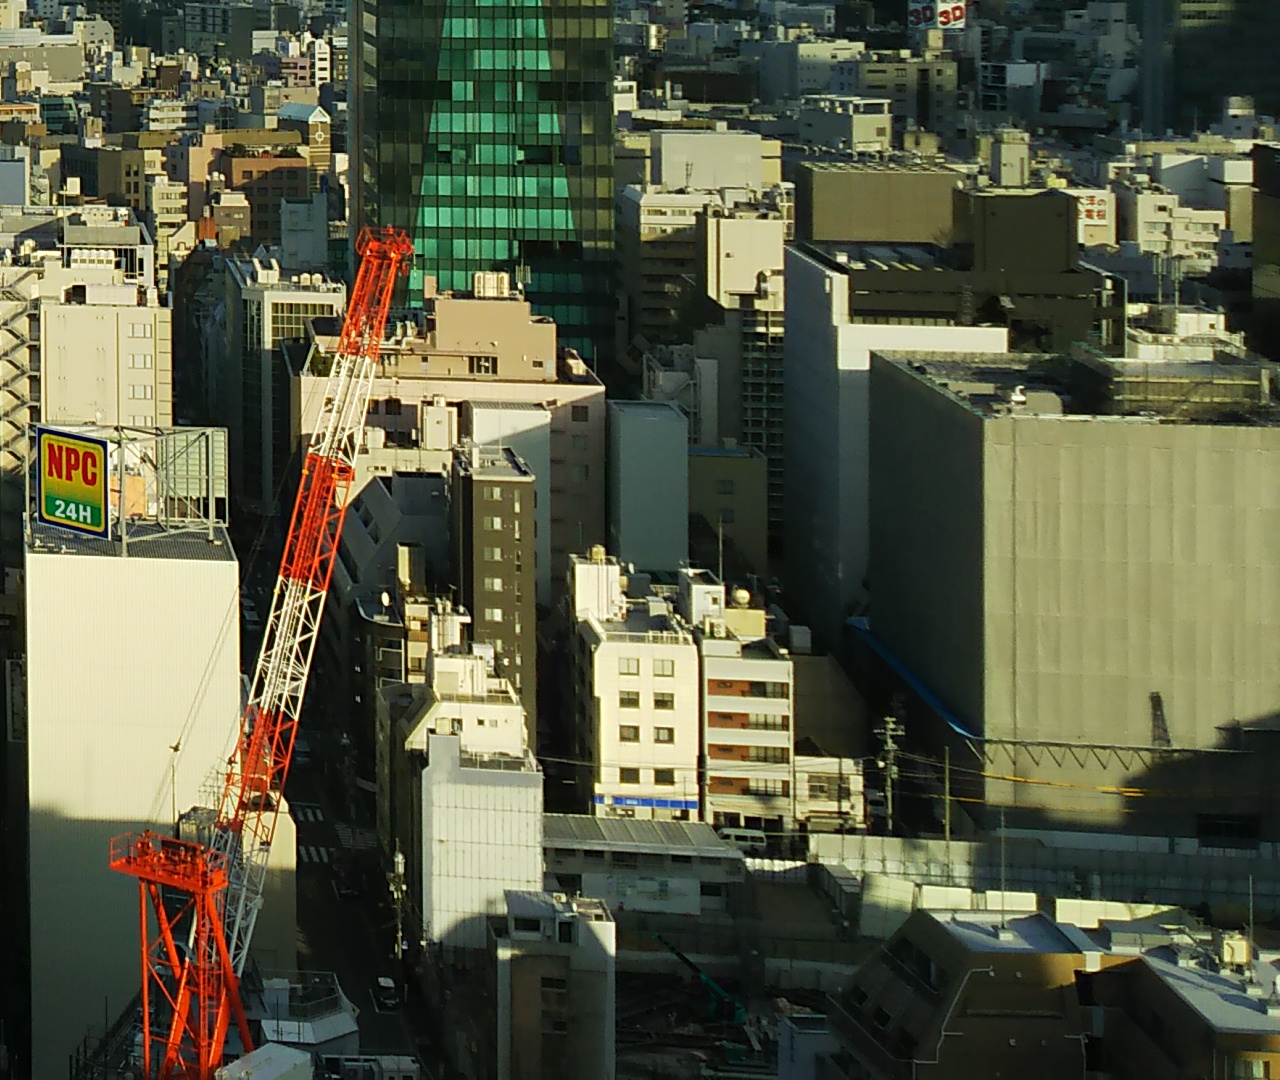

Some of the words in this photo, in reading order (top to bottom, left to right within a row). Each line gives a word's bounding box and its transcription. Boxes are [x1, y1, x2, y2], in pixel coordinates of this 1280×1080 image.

[909, 5, 935, 26] 3D
[938, 5, 964, 26] 3D
[47, 442, 97, 487] NPC
[55, 499, 92, 524] 24H
